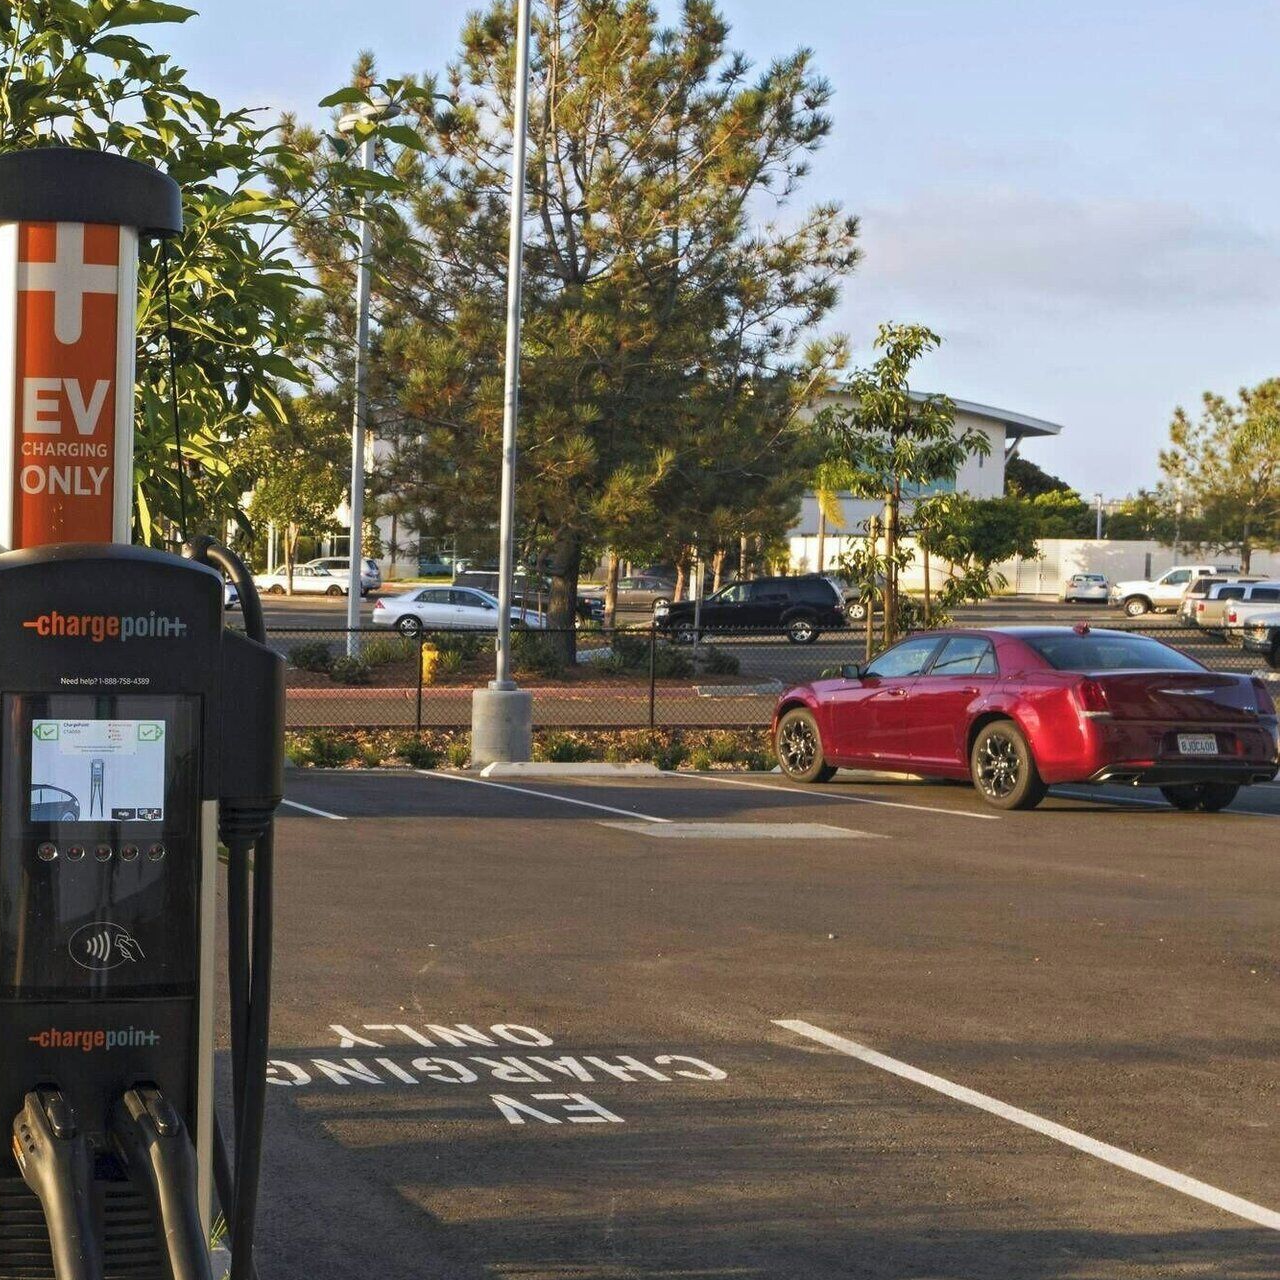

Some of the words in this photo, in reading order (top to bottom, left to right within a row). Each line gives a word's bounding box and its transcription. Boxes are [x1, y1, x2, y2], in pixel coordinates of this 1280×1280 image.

[22, 377, 110, 435] EV
[21, 441, 108, 458] CHARGING
[20, 464, 109, 496] ONLY
[60, 677, 79, 685] Need
[80, 677, 98, 686] help?
[329, 1023, 555, 1049] ONLY
[265, 1054, 729, 1087] CHARGING
[489, 1092, 625, 1124] EV
